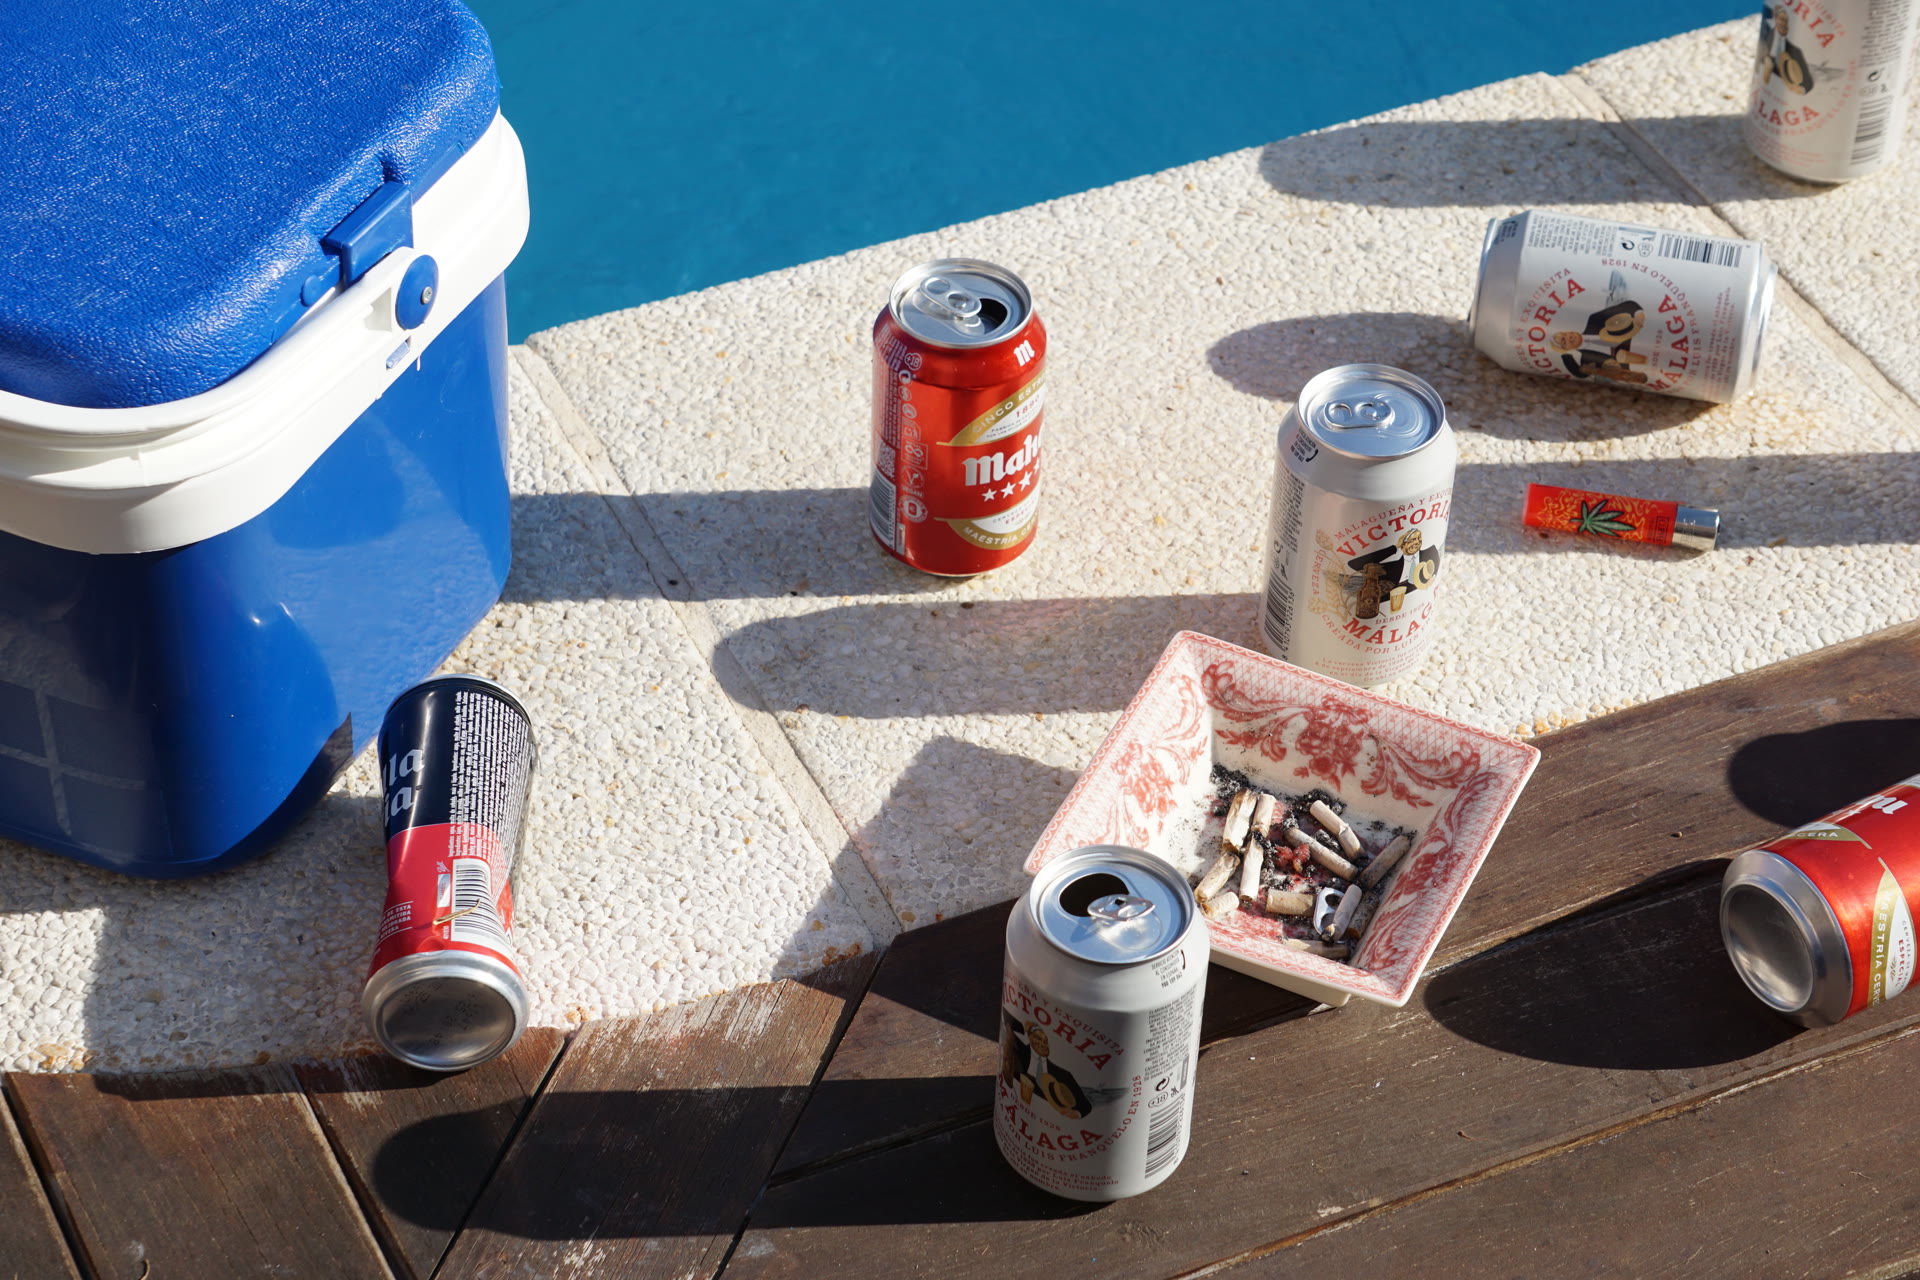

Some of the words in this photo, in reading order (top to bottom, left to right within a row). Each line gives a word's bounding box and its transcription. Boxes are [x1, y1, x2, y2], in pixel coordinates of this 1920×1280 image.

[1752, 88, 1820, 127] LAGA
[1601, 258, 1628, 268] 1928
[1631, 261, 1649, 274] EN
[1527, 278, 1587, 379] ICTORIA
[972, 401, 1014, 434] CINCO
[1334, 501, 1415, 541] MALAGUEÑA
[1311, 549, 1327, 596] CERVEZA
[1321, 613, 1362, 651] CREADA
[1364, 646, 1391, 655] POR
[1375, 612, 1407, 625] DESDE
[395, 904, 412, 912] ESTA
[1895, 939, 1906, 989] ESPECIAL
[1003, 982, 1113, 1072] ICTORIA
[1054, 1007, 1125, 1056] EXQUISITA
[1132, 1074, 1143, 1098] 1928
[1127, 1100, 1140, 1116] EN
[1025, 1142, 1056, 1161] LUIS
[1060, 1117, 1133, 1162] FRANQUELO
